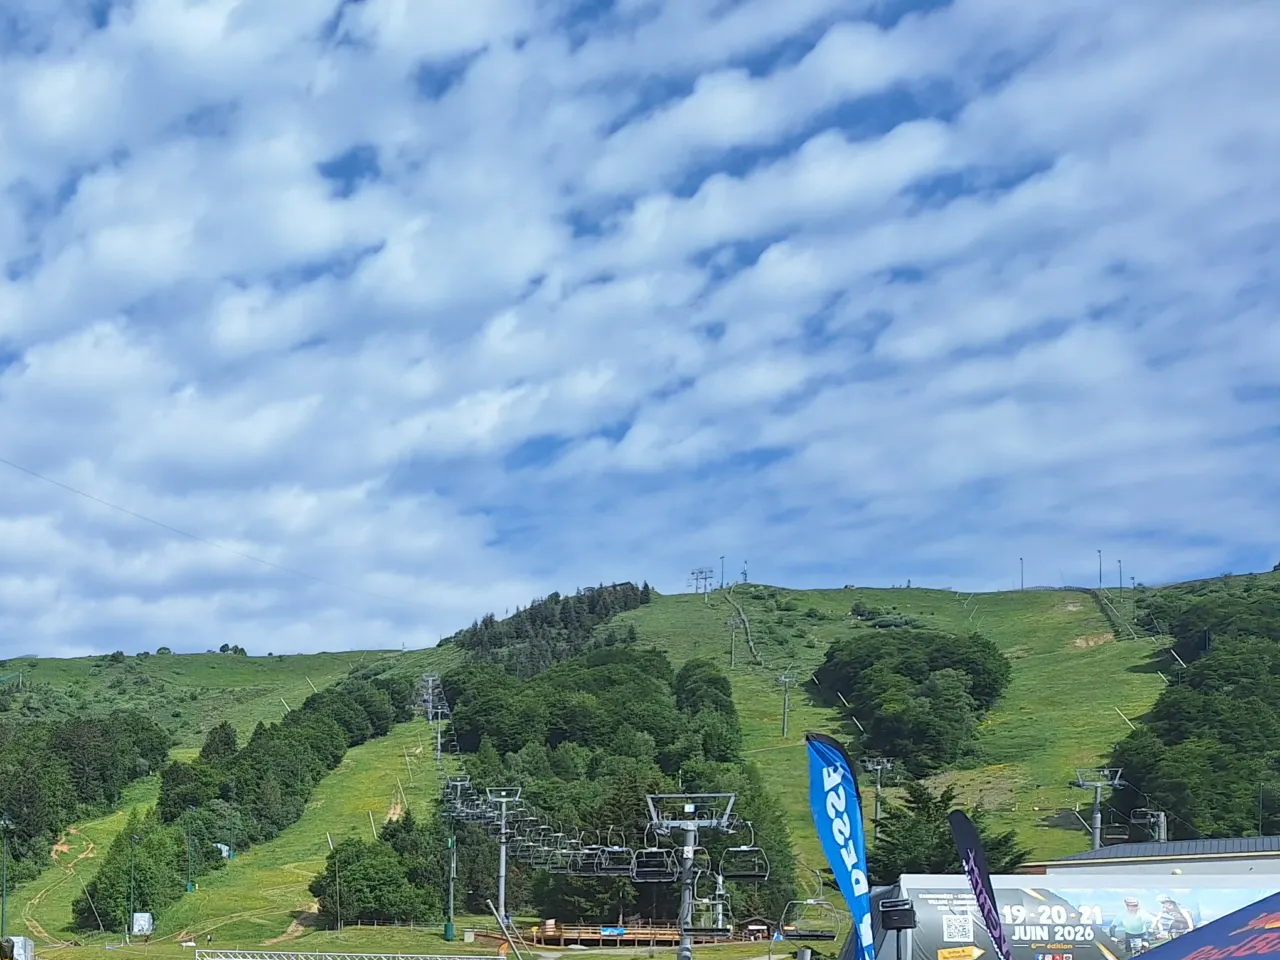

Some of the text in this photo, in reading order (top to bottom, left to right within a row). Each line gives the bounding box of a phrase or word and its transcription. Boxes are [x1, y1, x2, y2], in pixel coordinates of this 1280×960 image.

[1002, 905, 1025, 924] 19
[1038, 905, 1067, 924] 20
[1079, 905, 1103, 924] 21
[1012, 926, 1094, 941] JUIN 2026
